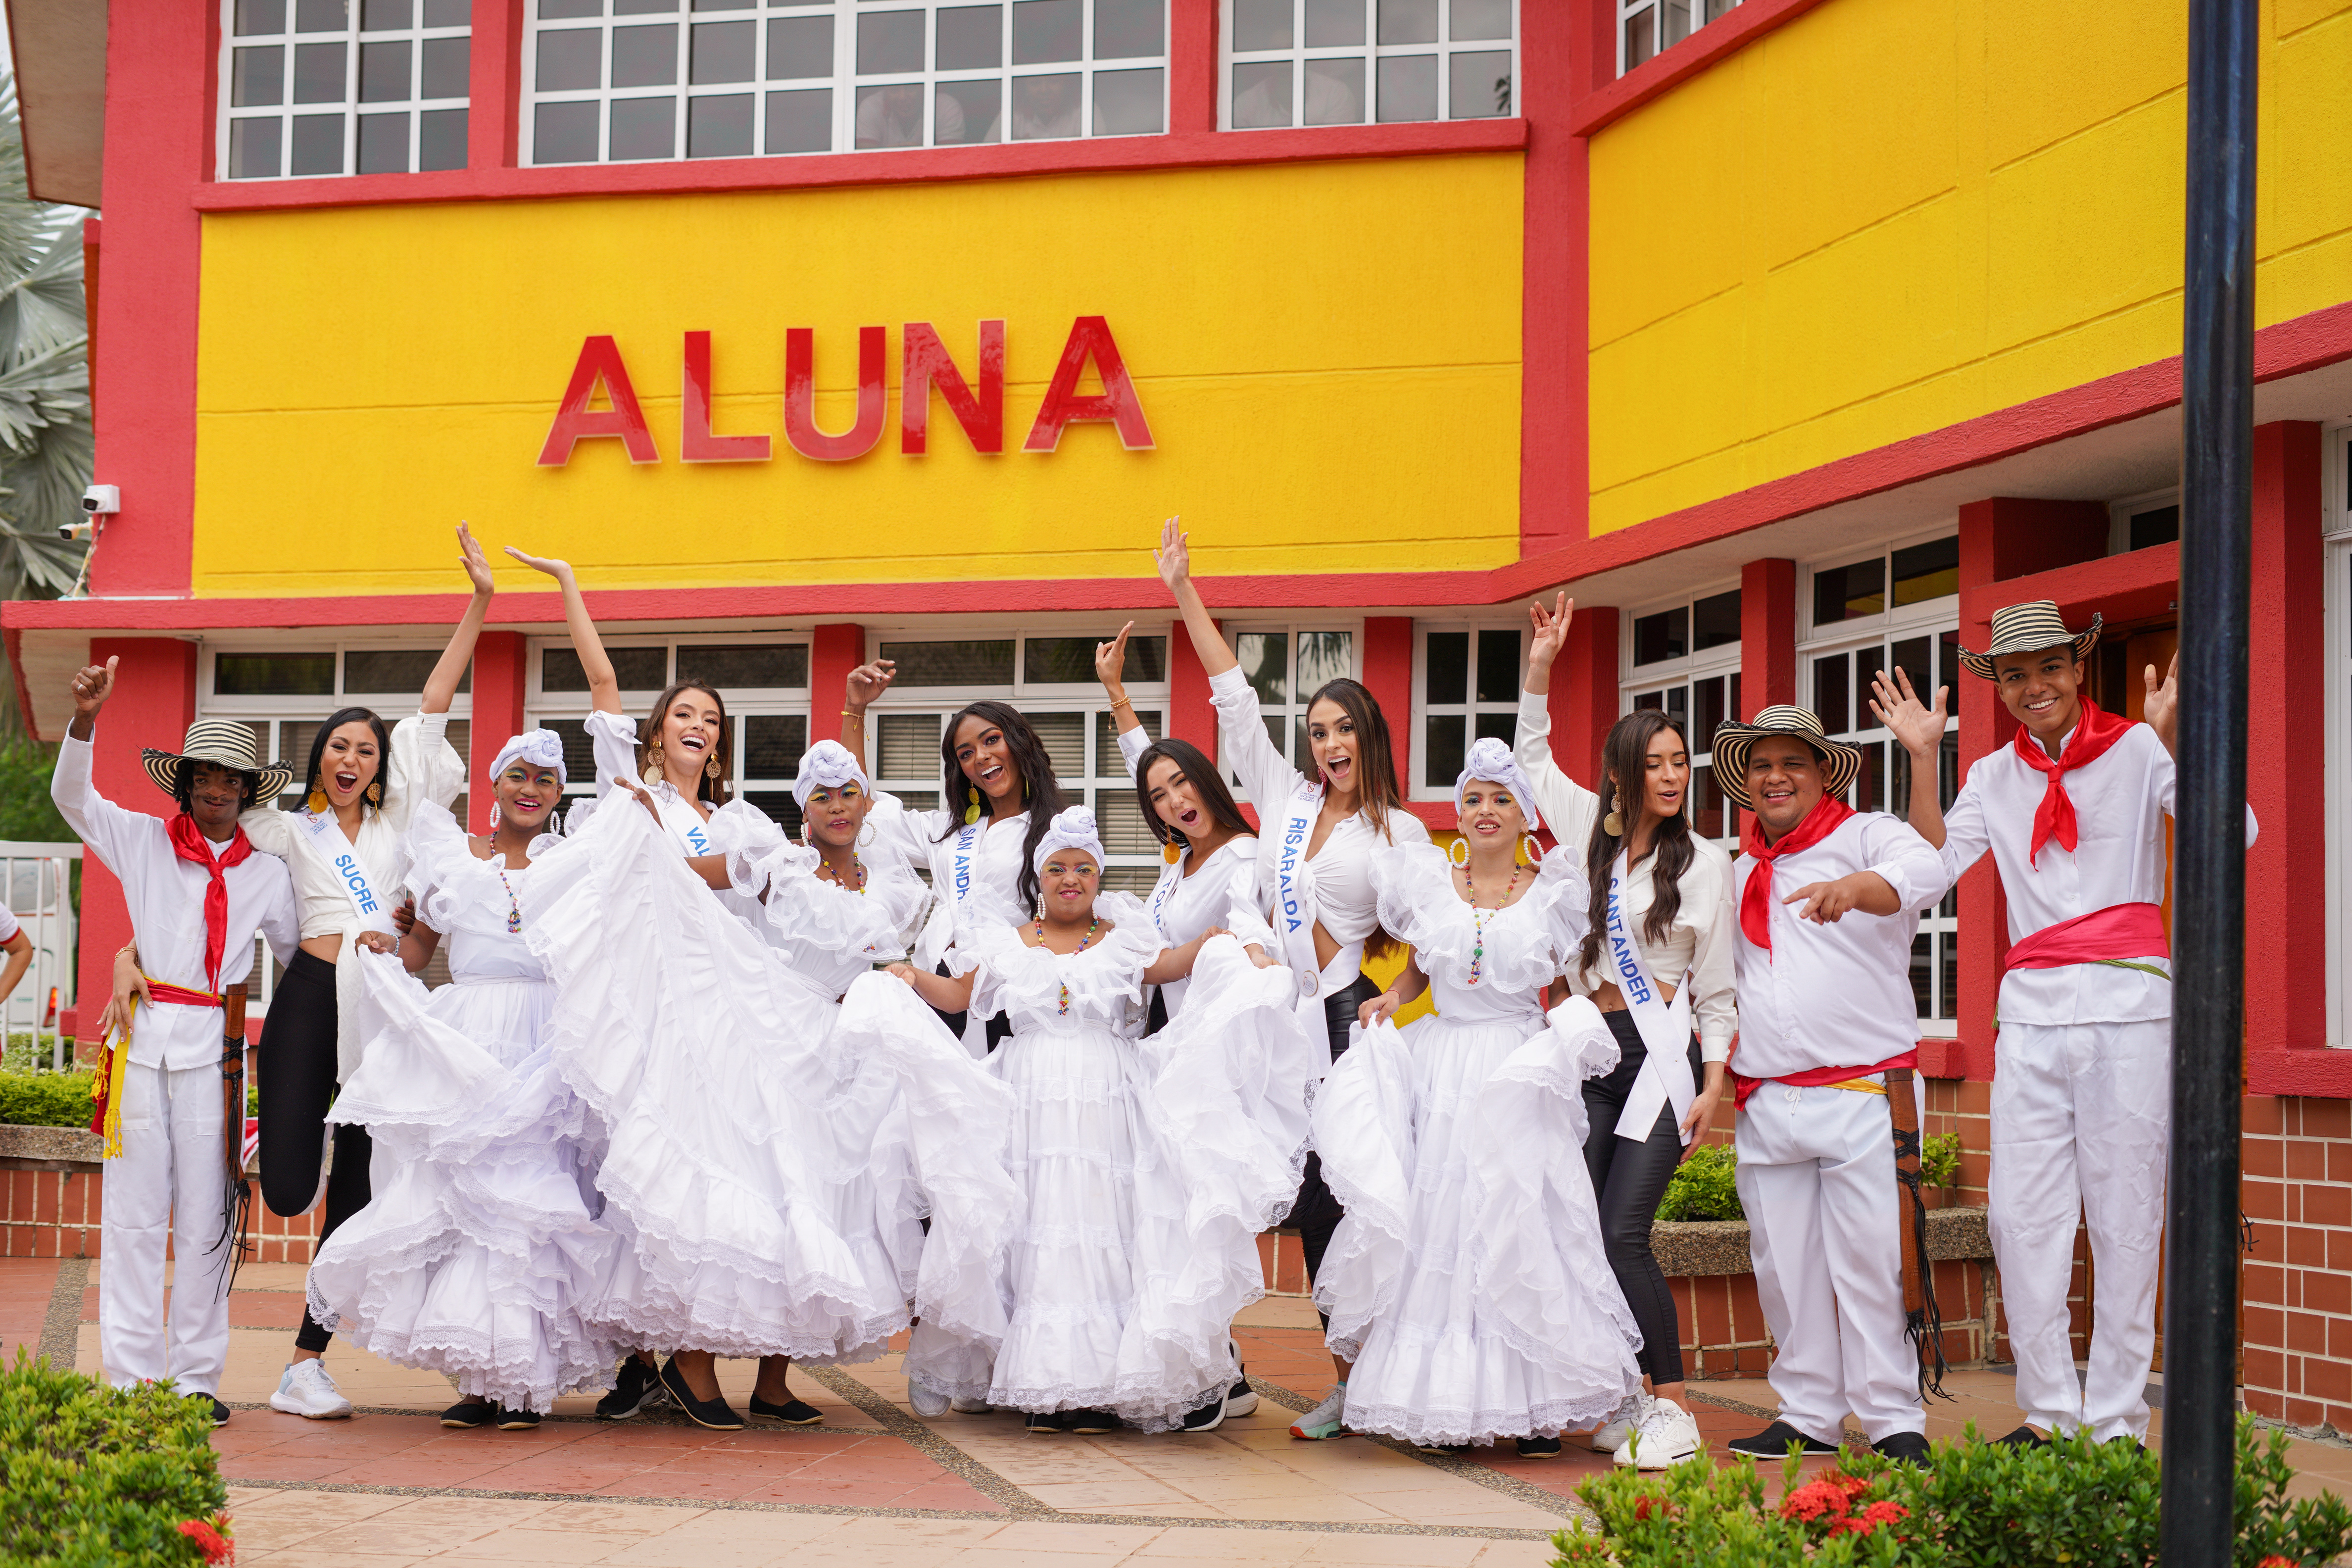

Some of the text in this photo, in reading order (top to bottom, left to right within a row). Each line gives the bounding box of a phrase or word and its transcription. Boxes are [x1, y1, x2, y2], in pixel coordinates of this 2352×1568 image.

[536, 315, 1157, 466] ALUNA
[335, 855, 378, 914] SUCRE
[956, 828, 976, 850] SAN
[1280, 817, 1308, 933] RISARALDA
[1608, 878, 1651, 1005] SANTANDER
